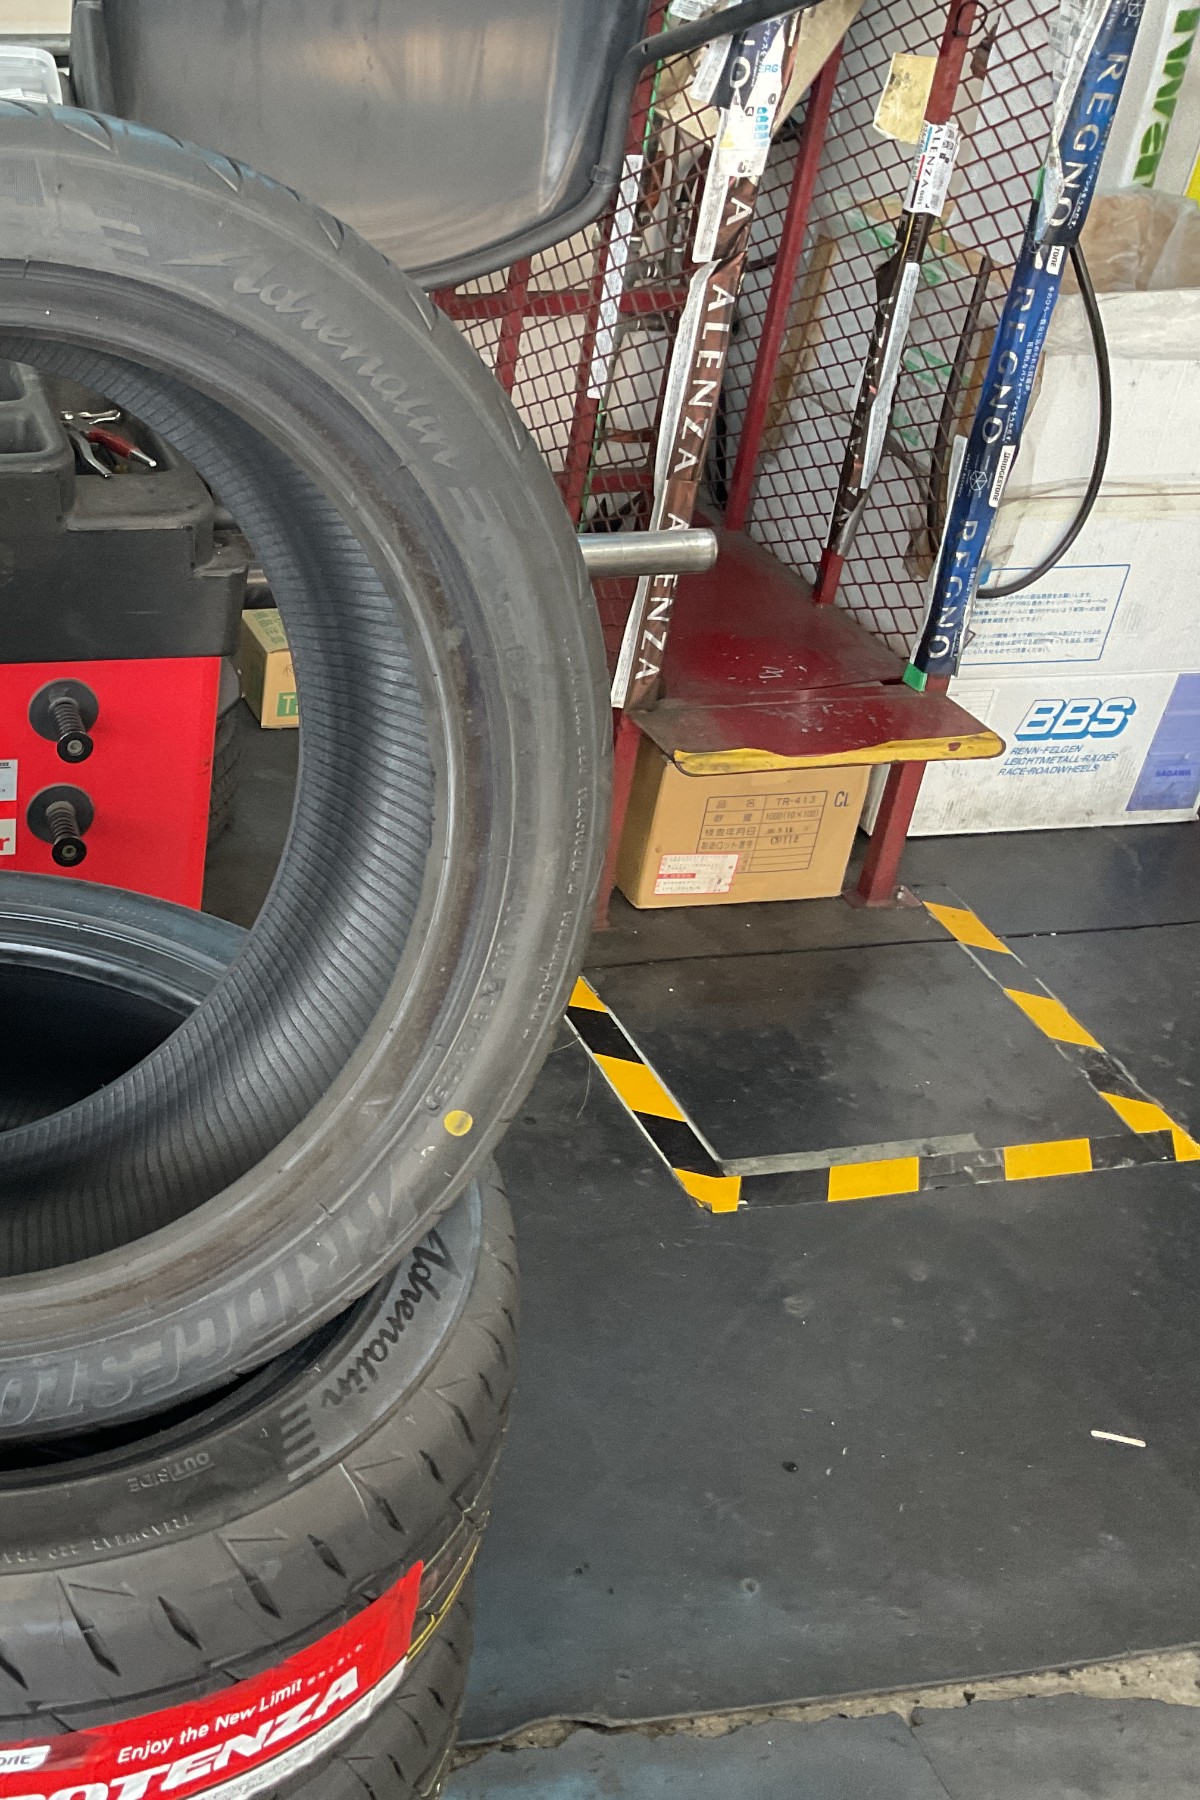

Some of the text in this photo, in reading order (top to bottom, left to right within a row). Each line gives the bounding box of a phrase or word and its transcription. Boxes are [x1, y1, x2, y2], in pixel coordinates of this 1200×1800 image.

[920, 125, 944, 188] ALENZA
[1049, 53, 1129, 228] REGNO
[673, 283, 735, 474] ALENZA
[981, 287, 1036, 444] REGNO
[1008, 744, 1084, 756] RENN-FELGEN
[1014, 696, 1138, 742] BBS
[776, 795, 817, 808] TR-413
[321, 1228, 463, 1408] Adrenalin
[116, 1676, 304, 1765] Enjoy the New Limit
